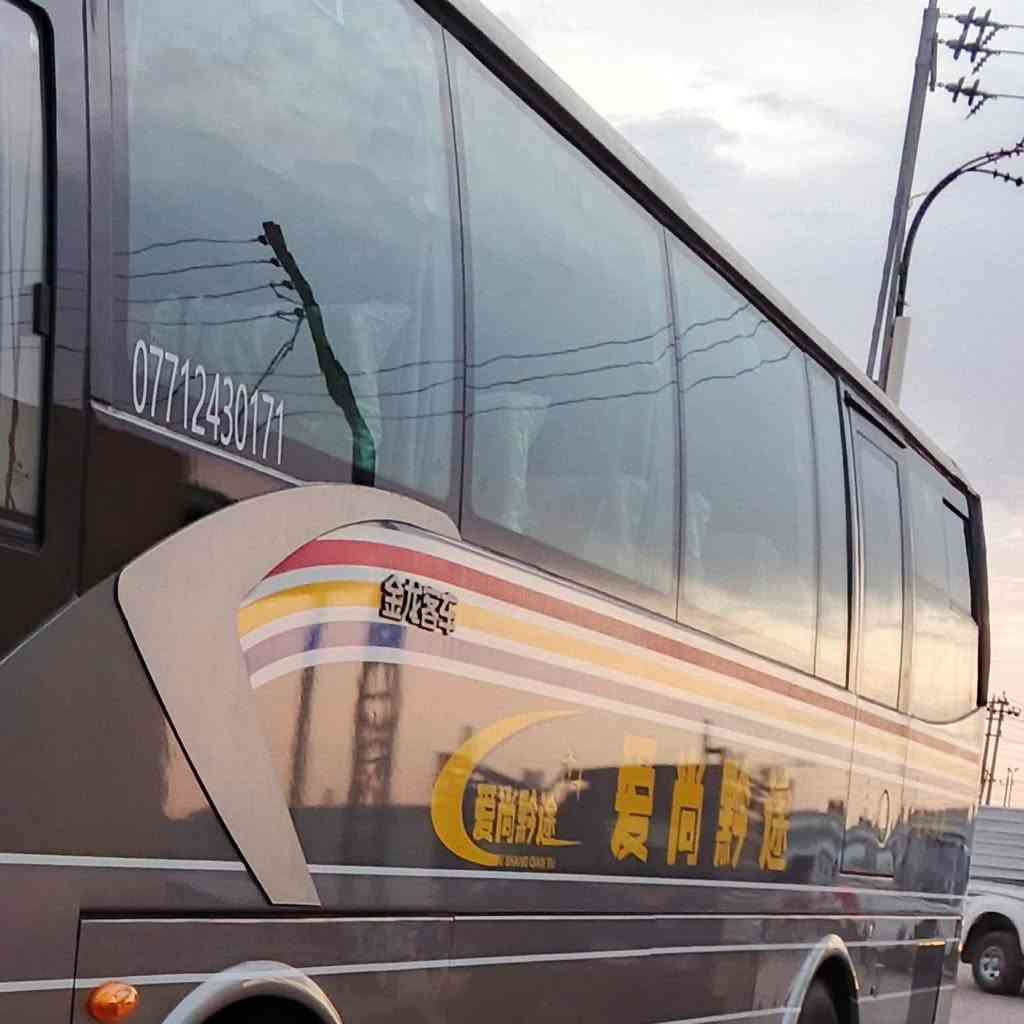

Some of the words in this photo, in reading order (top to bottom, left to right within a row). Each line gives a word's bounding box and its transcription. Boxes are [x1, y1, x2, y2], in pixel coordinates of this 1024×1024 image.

[133, 339, 284, 465] 07712430171
[378, 573, 457, 636] 金龙客车
